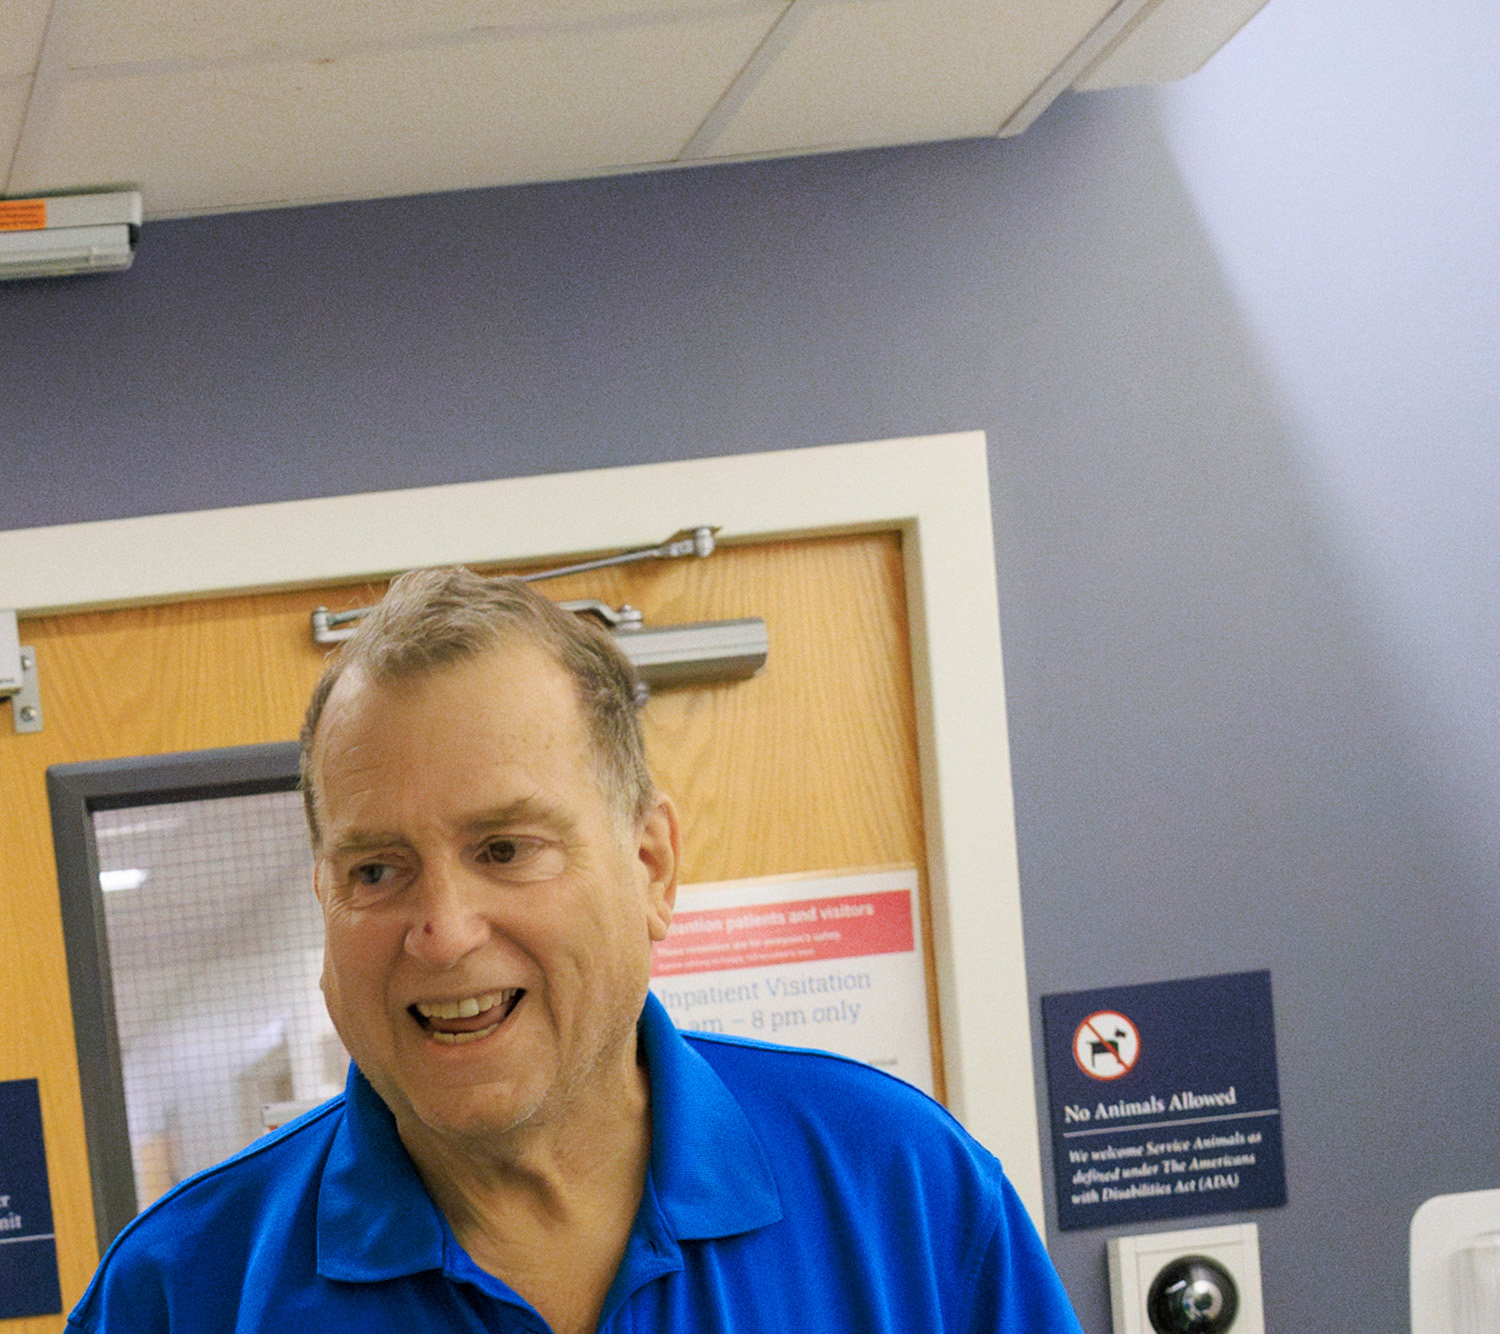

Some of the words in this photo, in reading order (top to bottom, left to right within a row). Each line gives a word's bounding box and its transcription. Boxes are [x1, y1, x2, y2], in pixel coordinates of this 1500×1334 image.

[788, 905, 818, 923] and
[819, 902, 875, 920] visitors
[660, 983, 759, 1012] Inpatient
[764, 972, 872, 997] Visitation
[751, 1009, 765, 1030] 8
[771, 1010, 807, 1033] pm
[811, 1000, 861, 1025] only
[1063, 1103, 1092, 1123] No
[1094, 1094, 1165, 1121] Animals
[1168, 1085, 1238, 1113] Allowed
[1069, 1149, 1090, 1163] We
[1091, 1144, 1145, 1161] welcome
[1146, 1138, 1191, 1156] Service
[1193, 1130, 1246, 1150] Animals
[1247, 1131, 1262, 1144] as
[1072, 1166, 1121, 1186] defined
[1121, 1162, 1159, 1178] under
[1161, 1159, 1187, 1175] The
[1188, 1152, 1257, 1172] Americans
[1071, 1188, 1100, 1205] with
[1101, 1181, 1173, 1203] Disabilities
[1173, 1178, 1197, 1194] Act
[1198, 1172, 1241, 1192] (ADA)
